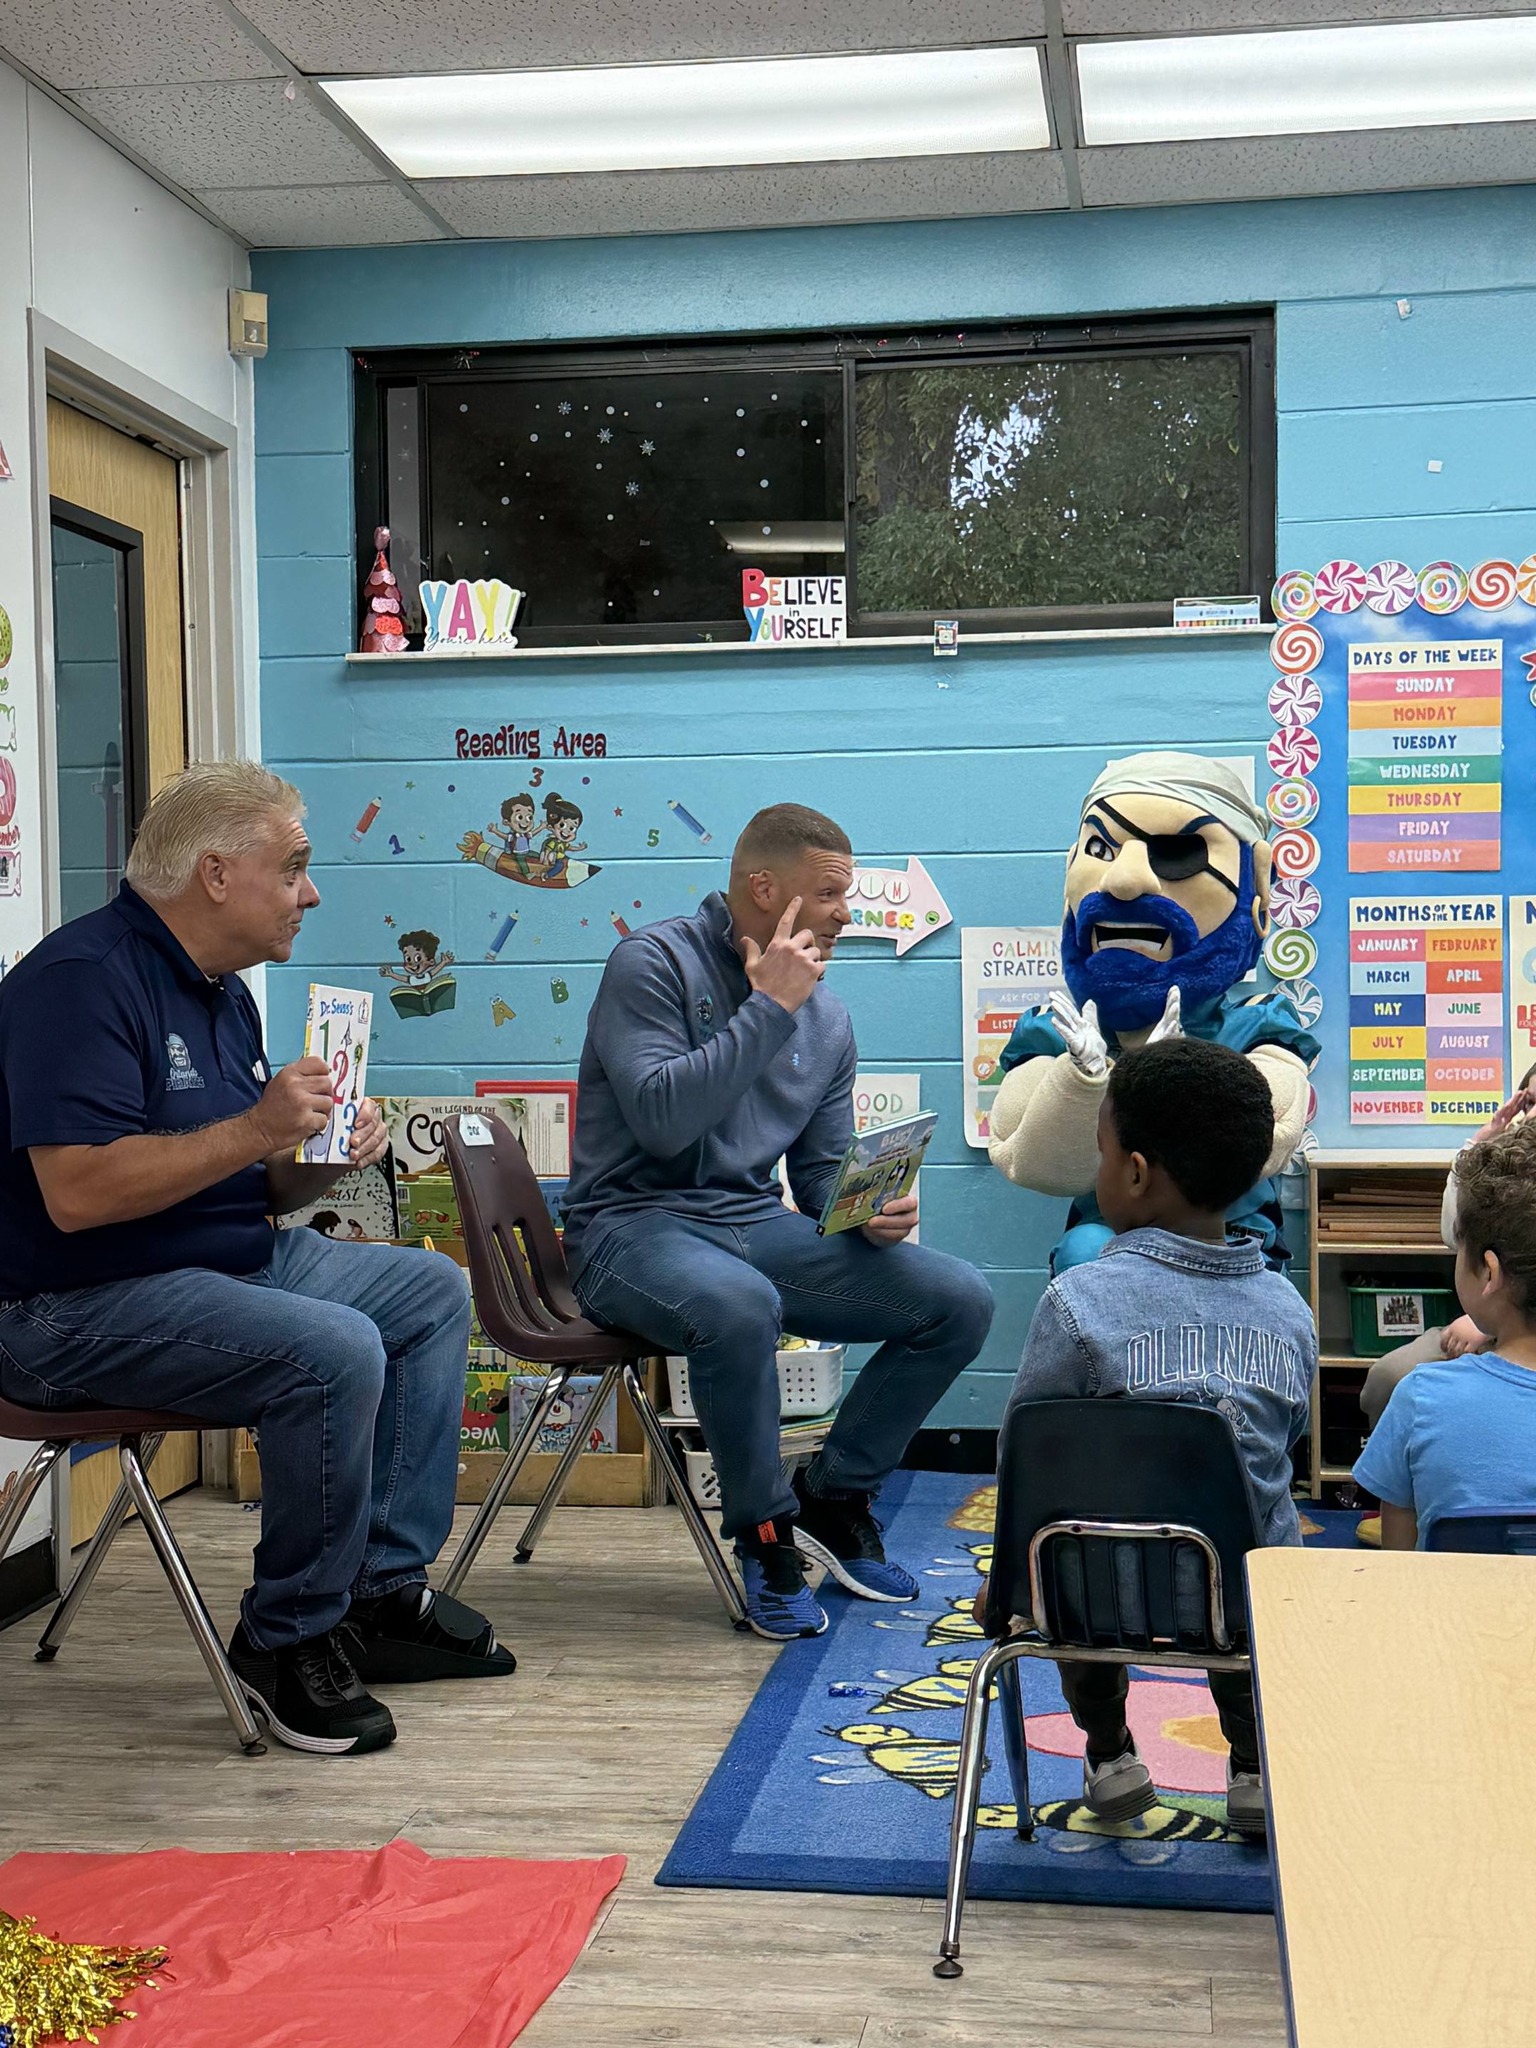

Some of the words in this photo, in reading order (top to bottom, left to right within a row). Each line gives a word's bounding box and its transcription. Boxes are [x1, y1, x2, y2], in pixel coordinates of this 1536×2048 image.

[742, 568, 843, 607] BELIEVE
[422, 583, 517, 641] YAY!
[789, 608, 801, 617] in
[743, 607, 843, 642] YOURSELF
[478, 628, 513, 644] here
[1353, 650, 1392, 665] DAYS
[1400, 650, 1417, 664] OF
[1424, 649, 1450, 663] THE
[1457, 648, 1497, 662] WEEK
[1395, 677, 1455, 693] SUNDAY
[1393, 707, 1456, 721] MONDAY
[455, 725, 541, 759] Reading
[553, 726, 607, 757] Area
[1392, 735, 1457, 750] TUESDAY
[529, 767, 544, 787] 3
[1379, 763, 1470, 778] WEDNESDAY
[1387, 792, 1462, 807] THURSDAY
[1398, 820, 1450, 836] FRIDAY
[389, 835, 405, 854] 1
[647, 829, 660, 848] 5
[1387, 848, 1462, 863] SATURDAY
[1356, 906, 1431, 922] MONTHS
[1434, 904, 1447, 912] OF
[1449, 904, 1496, 921] YEAR
[850, 908, 915, 930] RNER
[1432, 913, 1448, 922] THE
[993, 941, 1061, 957] CALMIN
[1357, 938, 1419, 952] JANUARY
[1432, 938, 1497, 952] FEBRUARY
[983, 960, 1063, 977] STRATEG
[1366, 970, 1409, 983] MARCH
[1446, 969, 1482, 982] APRIL
[551, 979, 569, 1004] B
[1000, 994, 1019, 1003] ASK
[1021, 994, 1041, 1002] FOR
[320, 1001, 331, 1017] Dr.
[490, 996, 517, 1027] A
[1374, 1002, 1402, 1016] MAY
[1448, 1003, 1481, 1014] JUNE
[319, 1019, 330, 1063] 1
[1372, 1036, 1404, 1048] JULY
[1440, 1035, 1489, 1048] AUGUST
[332, 1051, 349, 1105] 2
[1352, 1068, 1424, 1081] SEPTEMBER
[1434, 1067, 1495, 1080] OCTOBER
[431, 1106, 442, 1114] THE
[445, 1104, 473, 1115] LEGEND
[857, 1093, 903, 1113] OOD
[1353, 1101, 1424, 1114] NOVEMBER
[1431, 1101, 1499, 1114] DECEMBER
[339, 1102, 358, 1157] 3
[1127, 1324, 1205, 1395] OLD
[1218, 1325, 1298, 1400] NAVY
